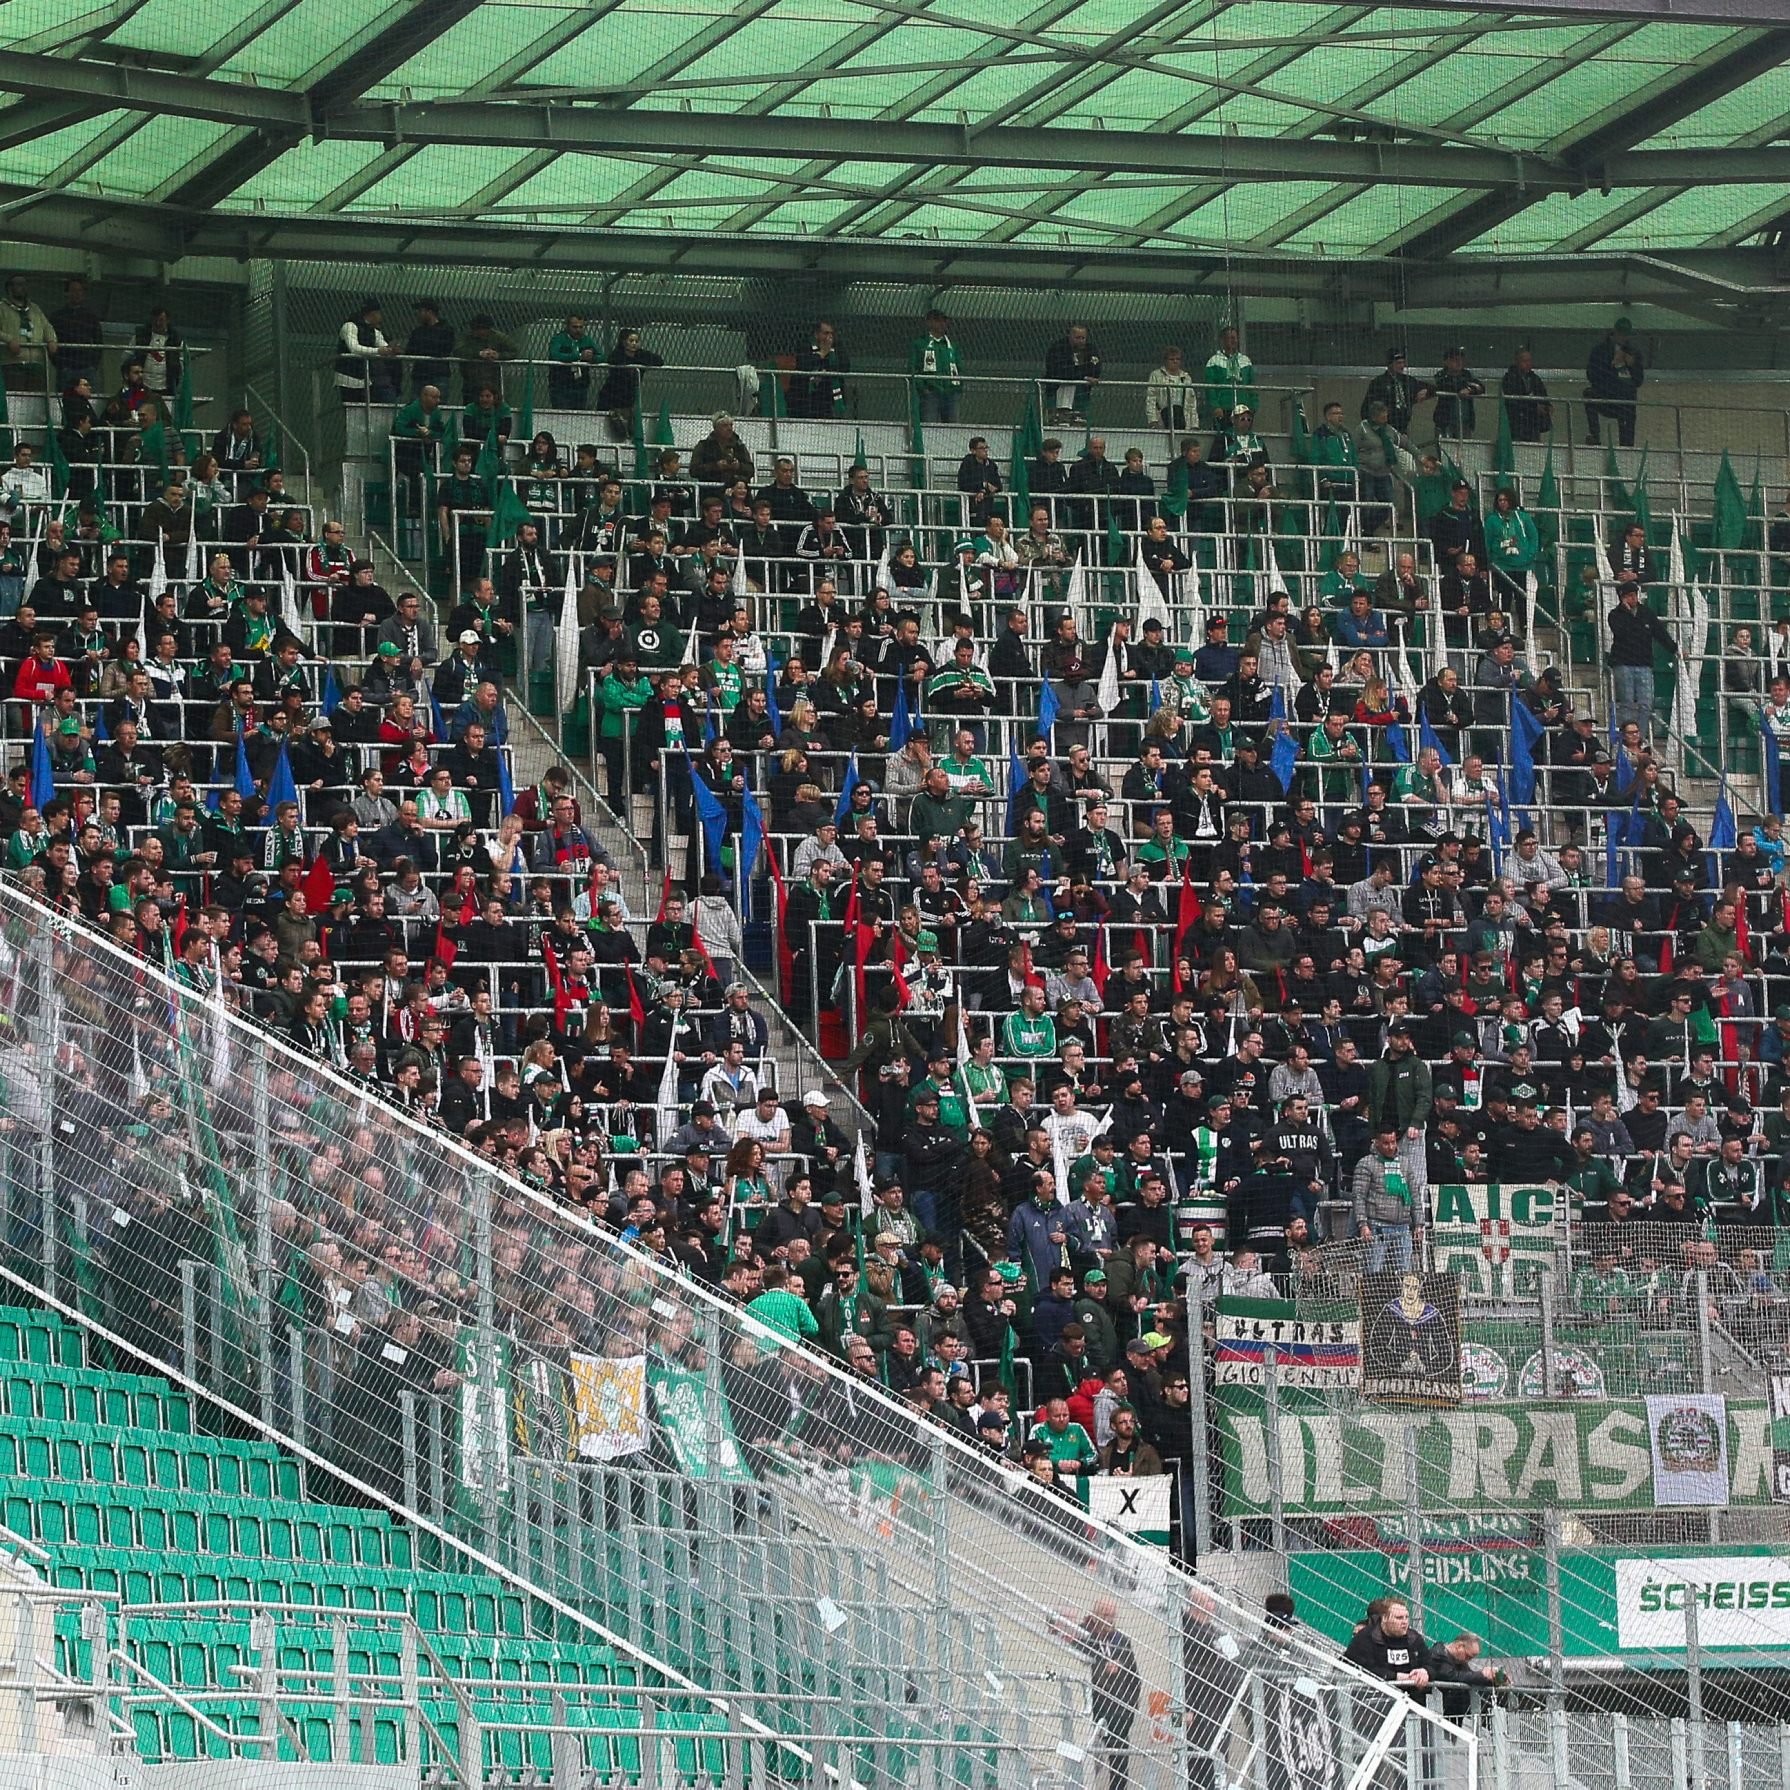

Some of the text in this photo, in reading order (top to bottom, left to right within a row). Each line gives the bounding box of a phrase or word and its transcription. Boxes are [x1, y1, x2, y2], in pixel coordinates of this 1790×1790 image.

[1278, 1135, 1318, 1150] ULTRAS
[1436, 1183, 1554, 1228] AIC
[1228, 1408, 1651, 1504] ULTRAS
[1119, 1488, 1140, 1515] X
[1388, 1553, 1530, 1586] MEIDLING
